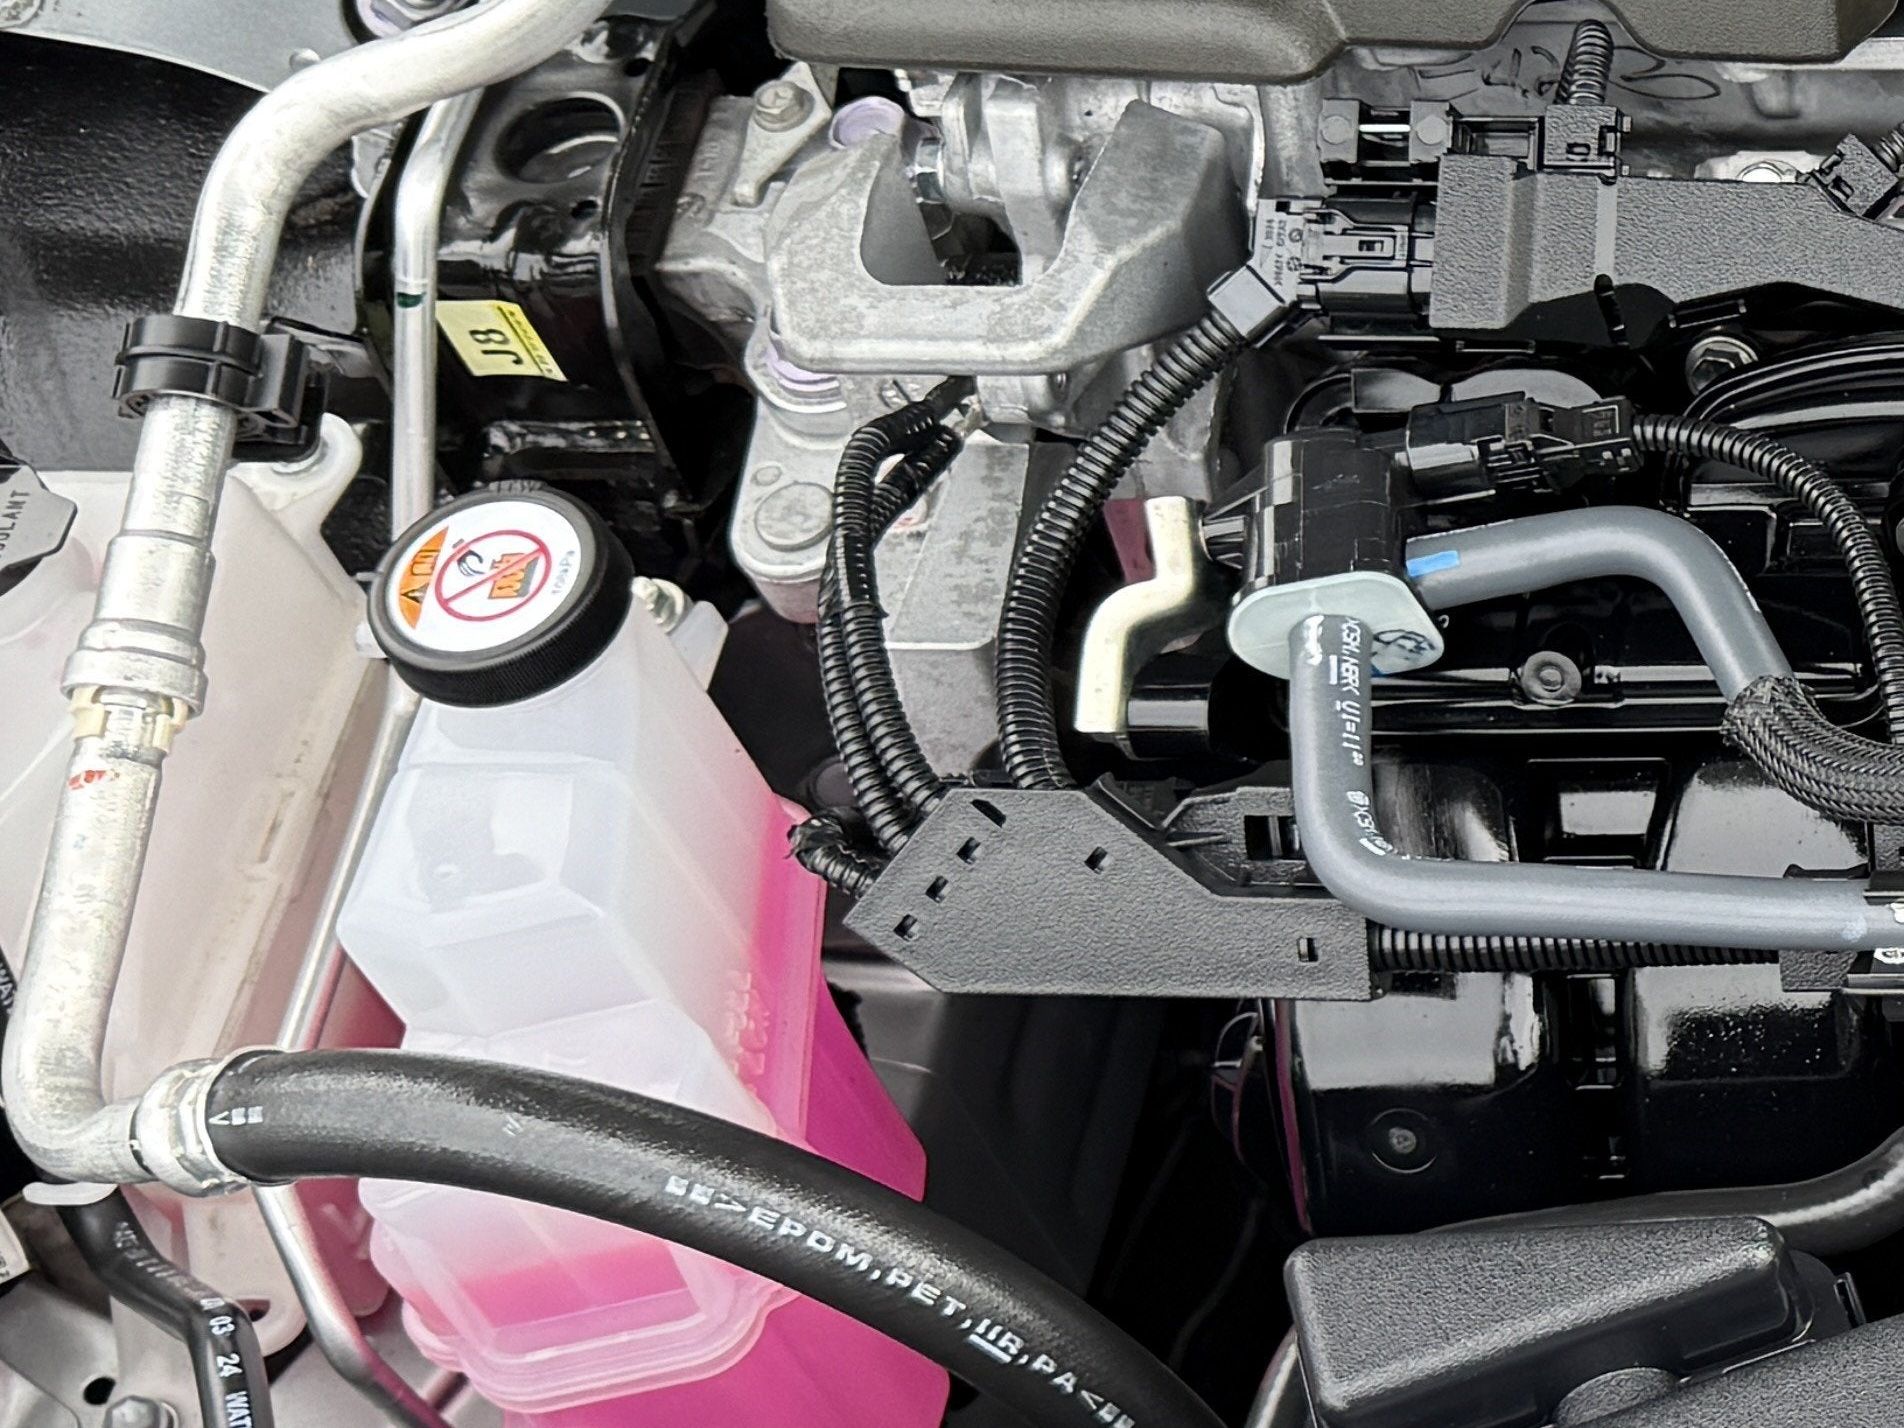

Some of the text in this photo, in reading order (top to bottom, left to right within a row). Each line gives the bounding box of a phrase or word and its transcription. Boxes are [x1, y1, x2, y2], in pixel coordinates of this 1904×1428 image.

[469, 328, 524, 365] J8
[209, 1316, 236, 1336] 03
[216, 1352, 243, 1377] 24
